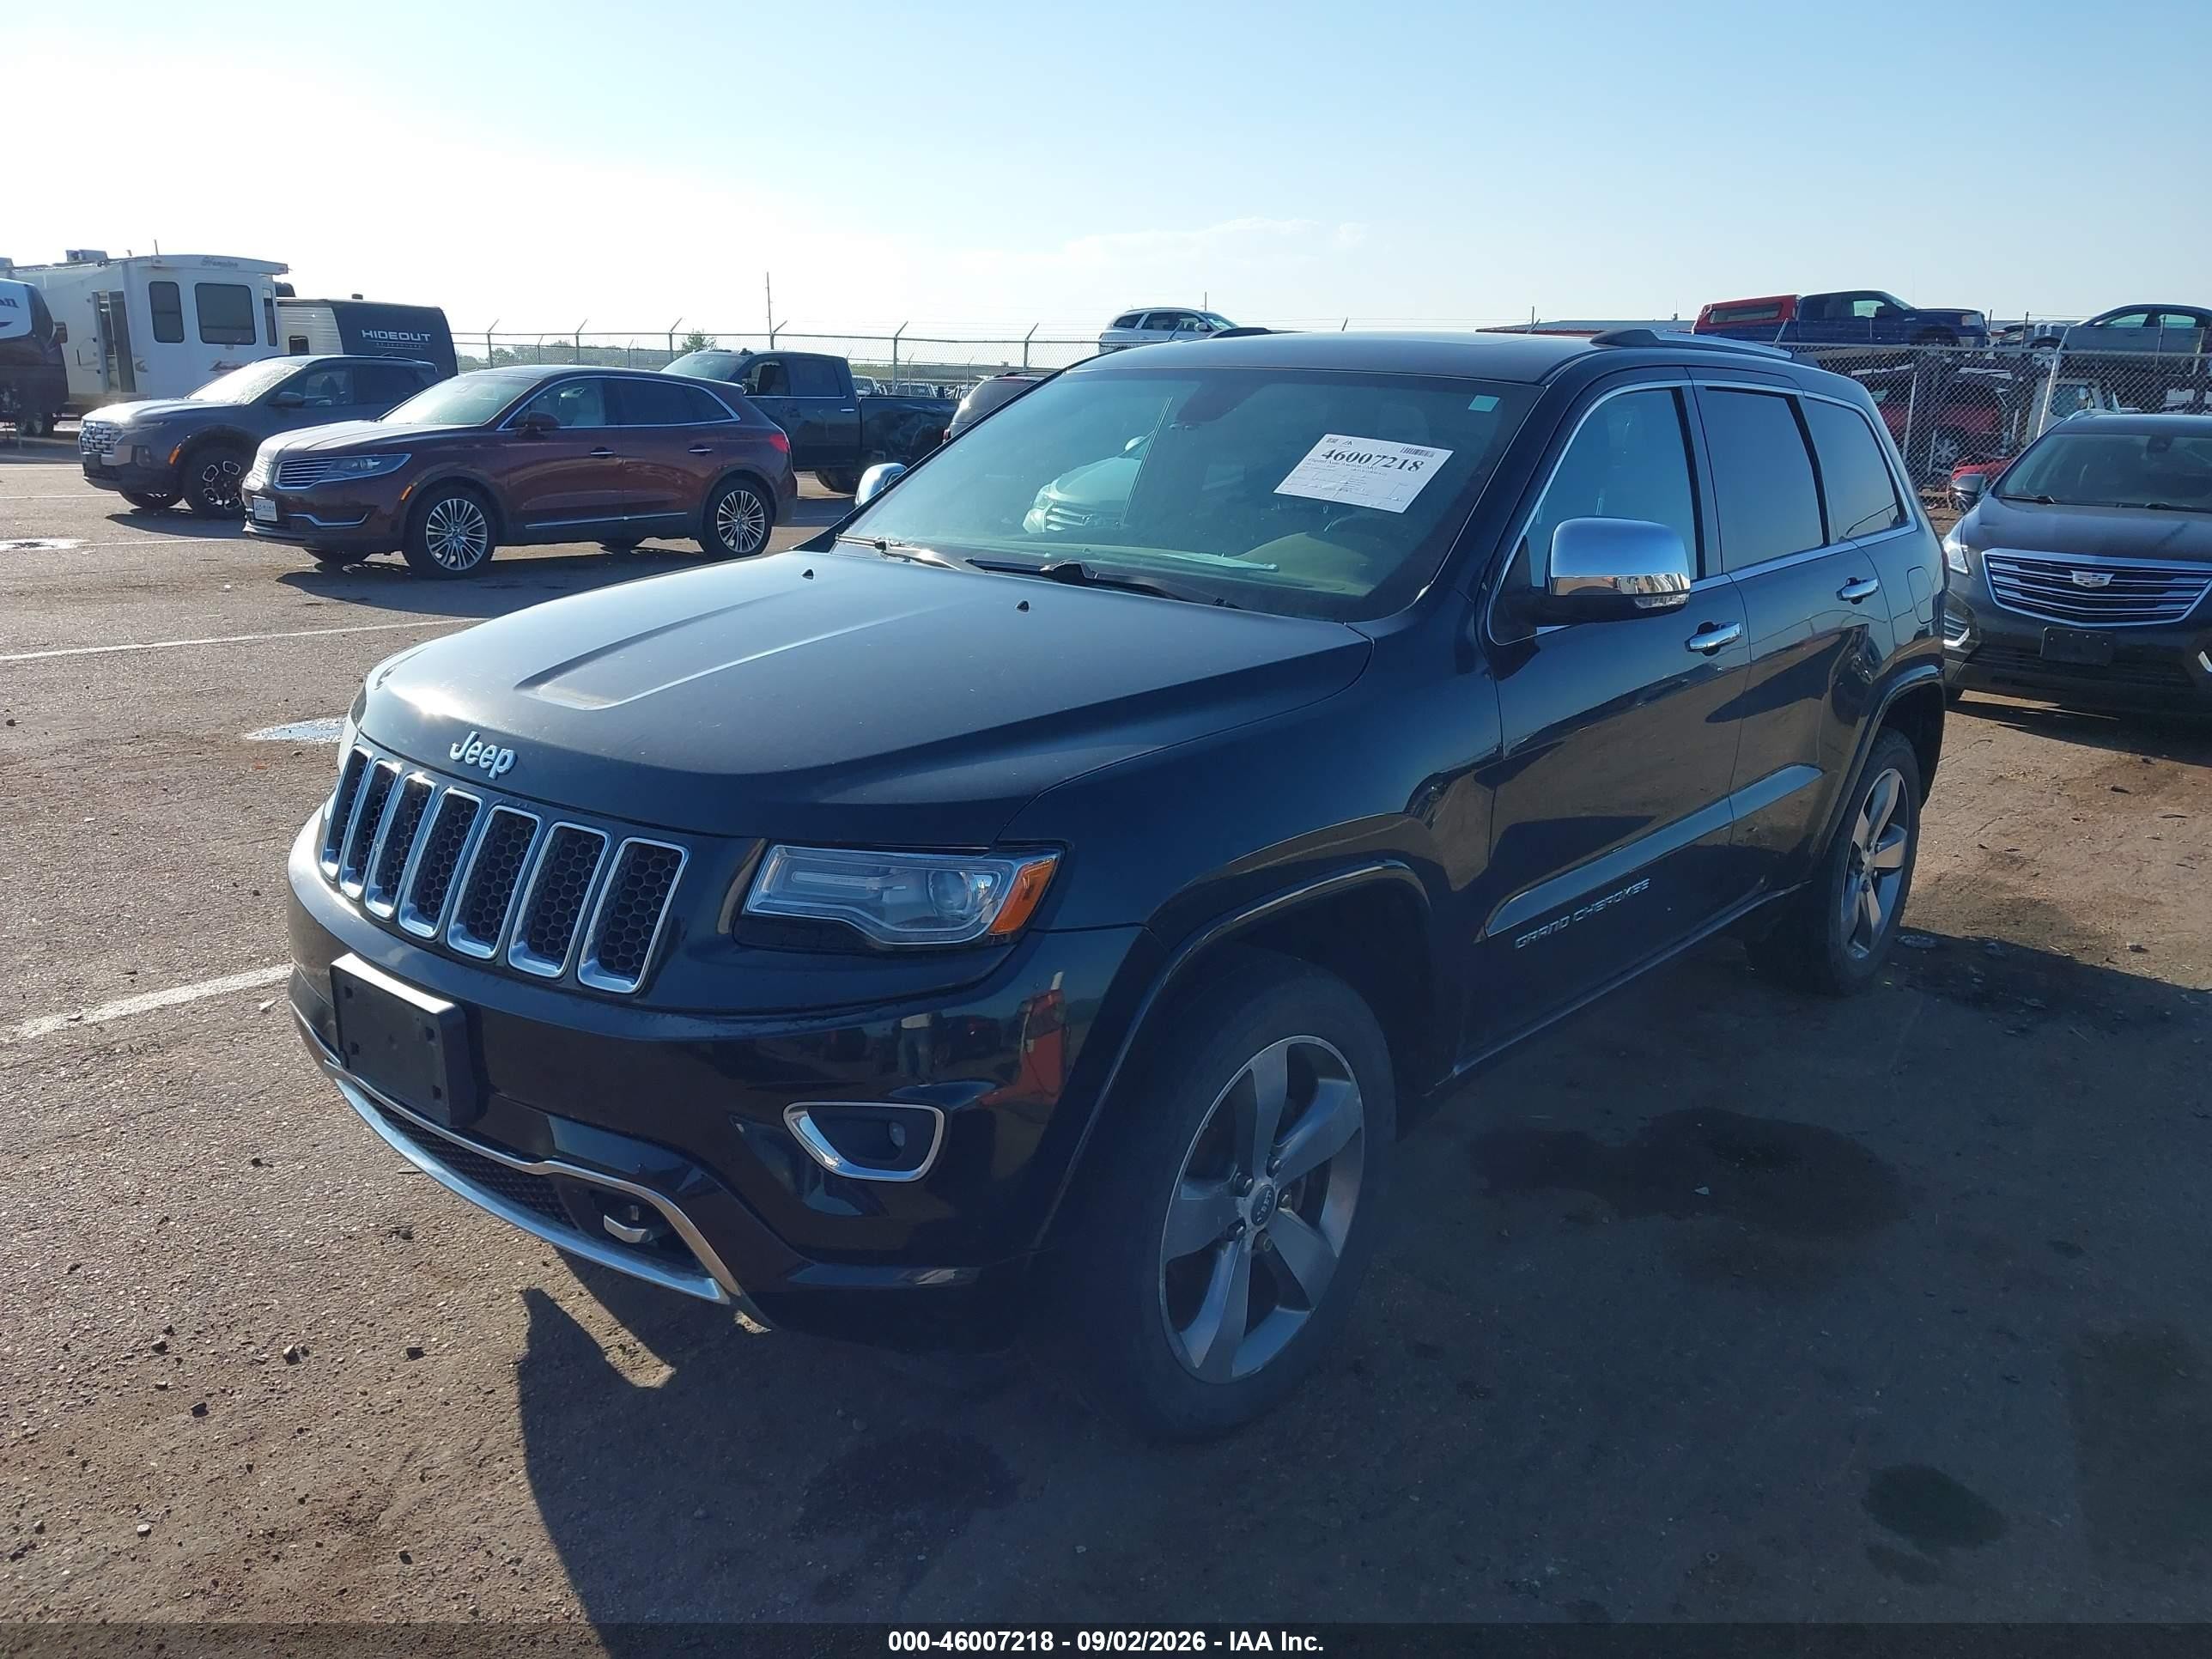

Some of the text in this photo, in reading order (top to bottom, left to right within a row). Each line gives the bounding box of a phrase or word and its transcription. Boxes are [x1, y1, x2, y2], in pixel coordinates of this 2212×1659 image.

[362, 329, 431, 342] HIDEOUT
[1321, 447, 1425, 472] 46007218
[449, 730, 516, 781] Jeep
[1515, 878, 1651, 949] GRAND CHEROKEE
